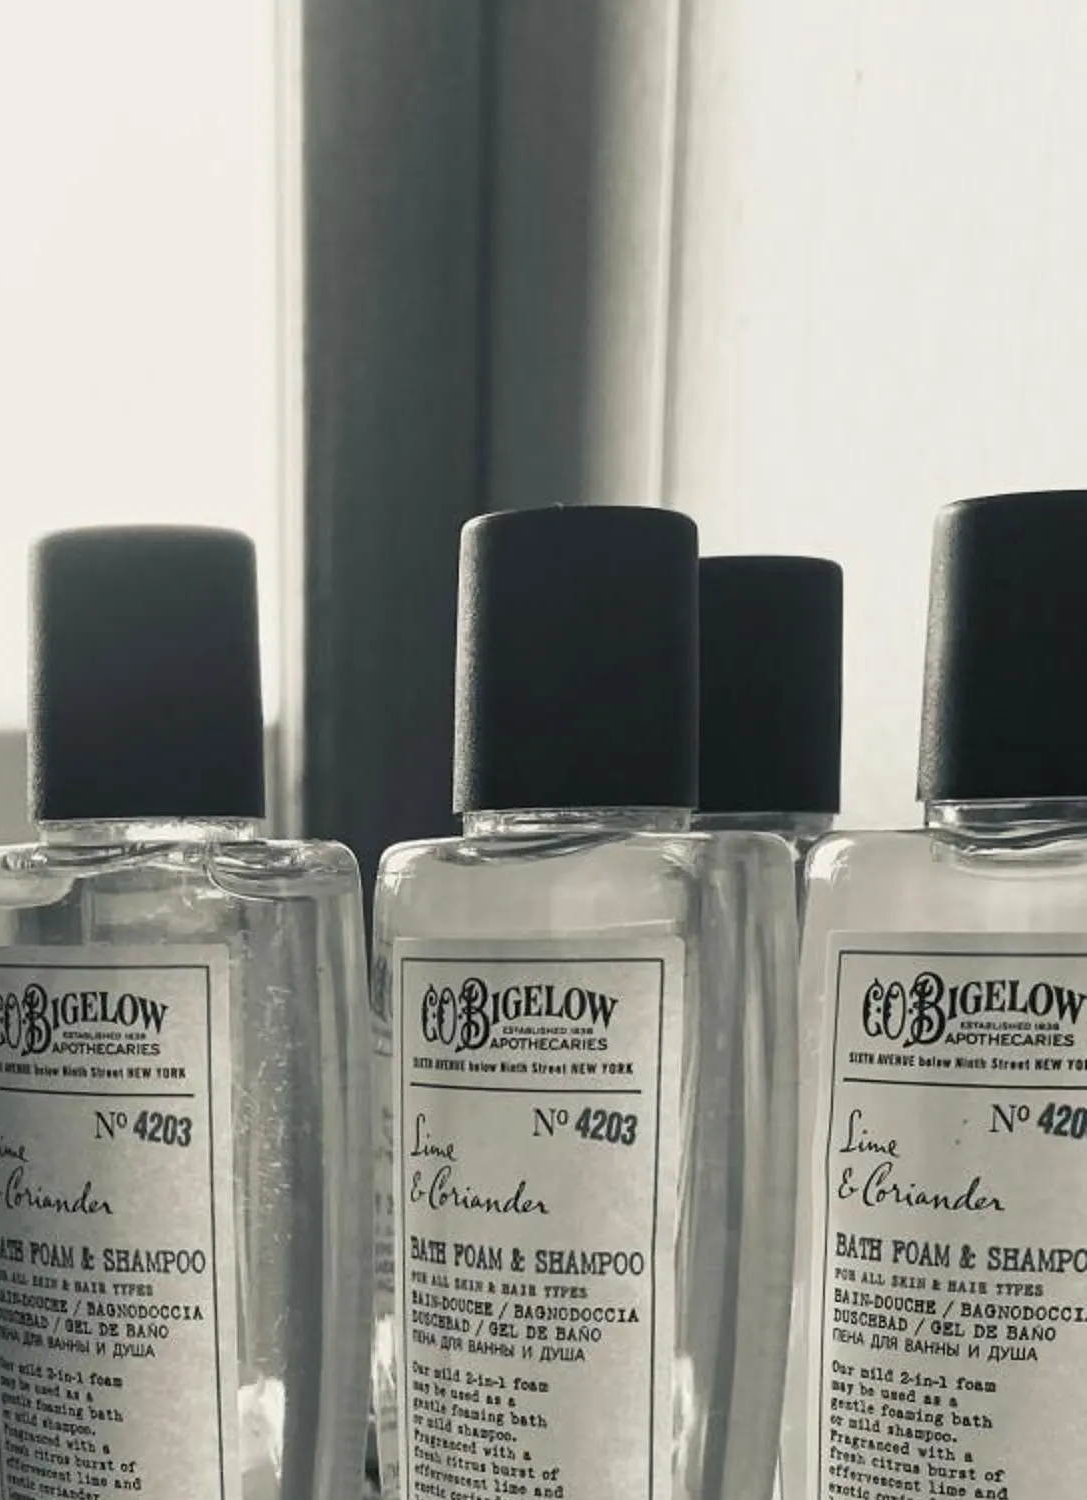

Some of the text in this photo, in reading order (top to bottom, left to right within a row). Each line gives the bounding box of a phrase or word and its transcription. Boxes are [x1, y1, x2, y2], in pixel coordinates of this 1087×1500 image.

[51, 1043, 161, 1056] APOTHECARIES
[490, 1037, 608, 1051] APOTHECARIES
[945, 1033, 1074, 1047] APOTHECARIES
[1068, 1058, 1087, 1071] YO
[133, 1110, 193, 1147] 4203
[575, 1107, 638, 1145] 4203
[1038, 1102, 1087, 1139] 420
[411, 1113, 457, 1161] Lime
[839, 1109, 901, 1158] Lime
[5, 1166, 112, 1215] Coriander
[429, 1166, 549, 1215] Coriander
[863, 1162, 1005, 1211] Coriander
[31, 1241, 74, 1269] FOAM
[103, 1248, 205, 1274] SHAMPOO
[411, 1236, 446, 1265] BATH
[454, 1242, 502, 1270] FOAM
[536, 1250, 644, 1276] SHAMPOO
[836, 1232, 882, 1261] BATH
[892, 1240, 950, 1268] FOAM
[987, 1246, 1087, 1272] SHAMPO
[87, 1301, 203, 1320] BAGNODOCCIA
[412, 1290, 493, 1316] BAIN-DOUCHE
[514, 1304, 640, 1322] BAGNODOCCIA
[834, 1288, 936, 1315] BAIN-DOUCHE
[961, 1302, 1087, 1322] BAGNODOCCI
[65, 1318, 92, 1334] GEL
[99, 1322, 119, 1337] DE
[412, 1309, 469, 1333] DUSCHBAD
[489, 1322, 517, 1338] GEL
[526, 1326, 548, 1340] DE
[834, 1308, 908, 1331] DUSCHBAD
[931, 1323, 965, 1337] GEL
[974, 1324, 998, 1339] DE
[113, 1344, 155, 1359] ДУША
[540, 1347, 585, 1362] ДУША
[905, 1338, 959, 1356] ВАННЫ
[987, 1347, 1038, 1362] ДУША
[47, 1368, 123, 1387] 2-in-1 foam
[466, 1373, 506, 1389] 2-in-1
[513, 1378, 549, 1392] foam
[901, 1372, 947, 1389] 2-in-1
[956, 1377, 997, 1392] foam
[511, 1412, 547, 1428] bath
[952, 1413, 993, 1428] bath
[483, 1445, 516, 1460] with
[918, 1444, 956, 1462] with
[493, 1463, 535, 1479] burst
[543, 1468, 560, 1480] of
[928, 1464, 976, 1481] burst
[984, 1470, 1005, 1482] of
[534, 1486, 564, 1499] and
[975, 1485, 1008, 1500] and
